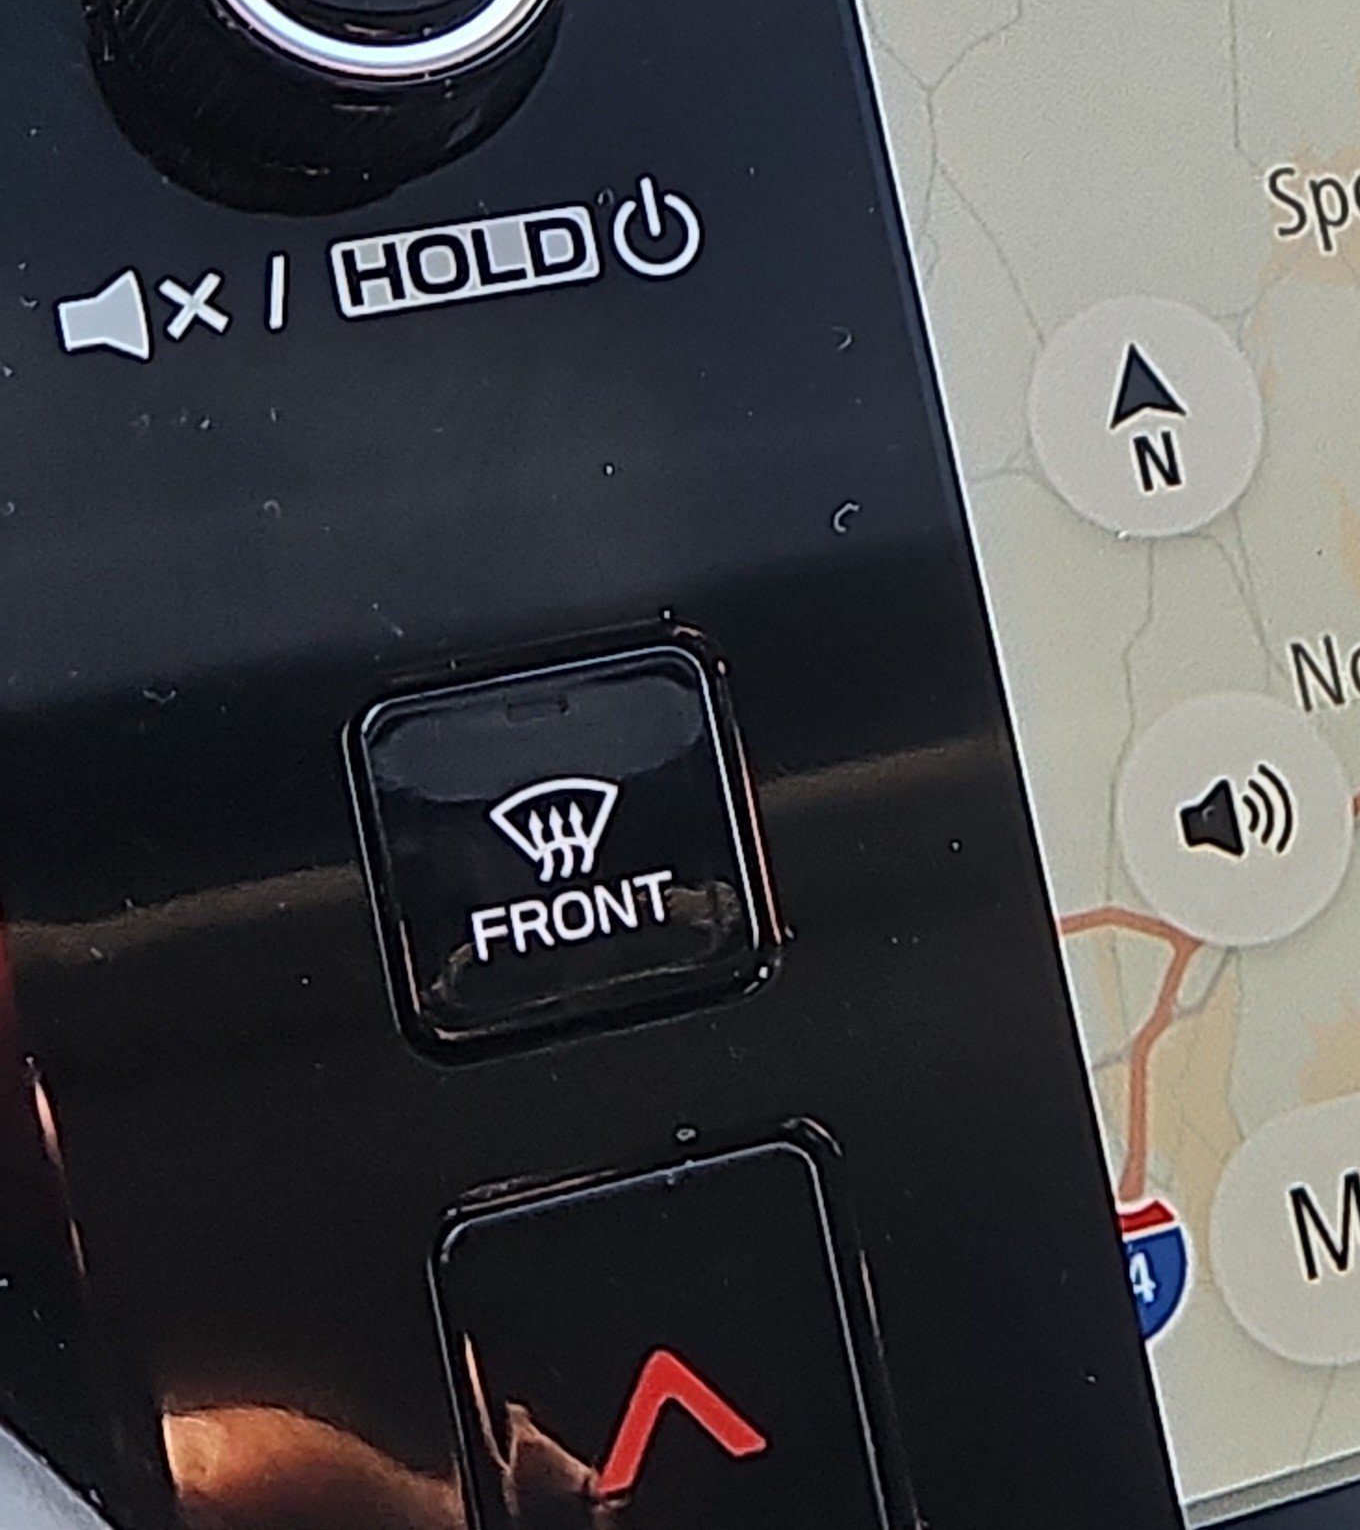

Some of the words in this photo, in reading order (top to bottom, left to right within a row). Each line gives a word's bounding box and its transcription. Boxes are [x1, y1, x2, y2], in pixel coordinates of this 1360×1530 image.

[341, 214, 590, 307] HOLD
[1133, 430, 1182, 491] N
[470, 869, 675, 964] FRONT
